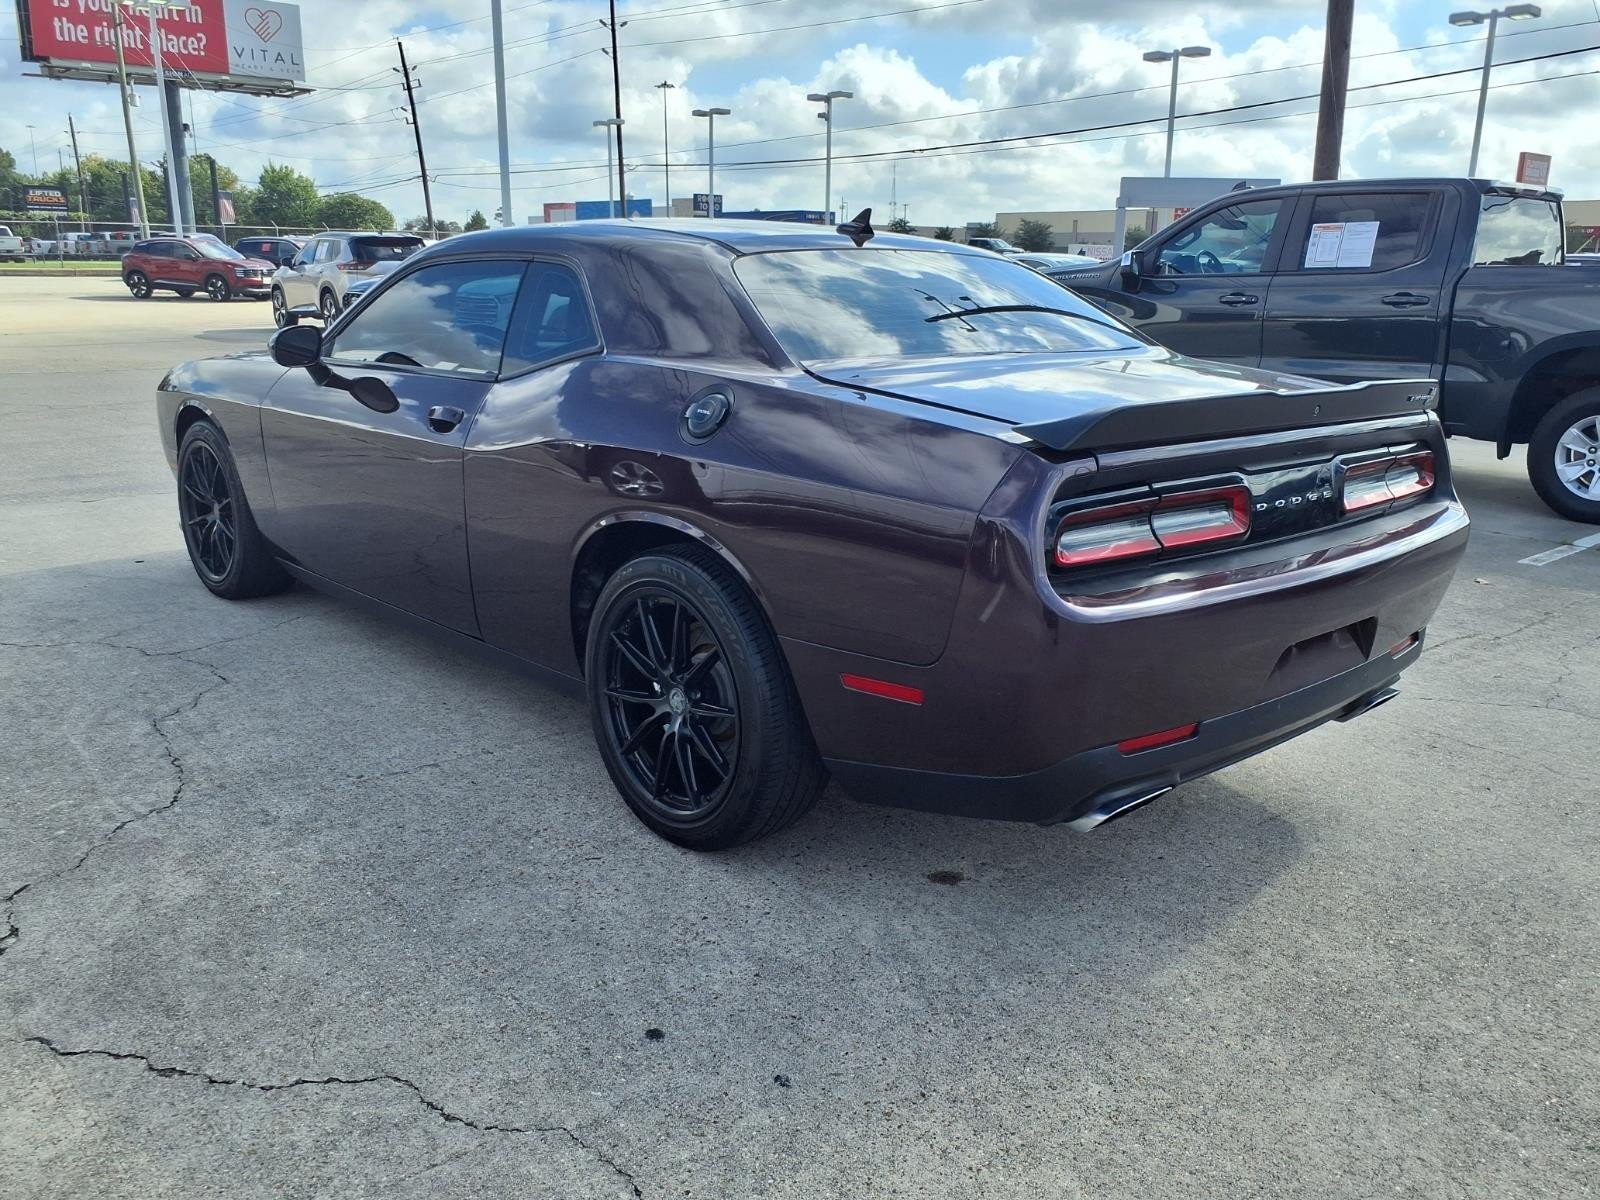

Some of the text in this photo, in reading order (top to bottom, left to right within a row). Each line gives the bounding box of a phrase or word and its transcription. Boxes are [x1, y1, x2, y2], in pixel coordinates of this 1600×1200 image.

[77, 0, 117, 13] you
[185, 3, 203, 23] in
[53, 16, 89, 43] the
[232, 46, 300, 65] VITAL
[1088, 247, 1114, 257] NISSA
[1256, 490, 1333, 511] DODGE
